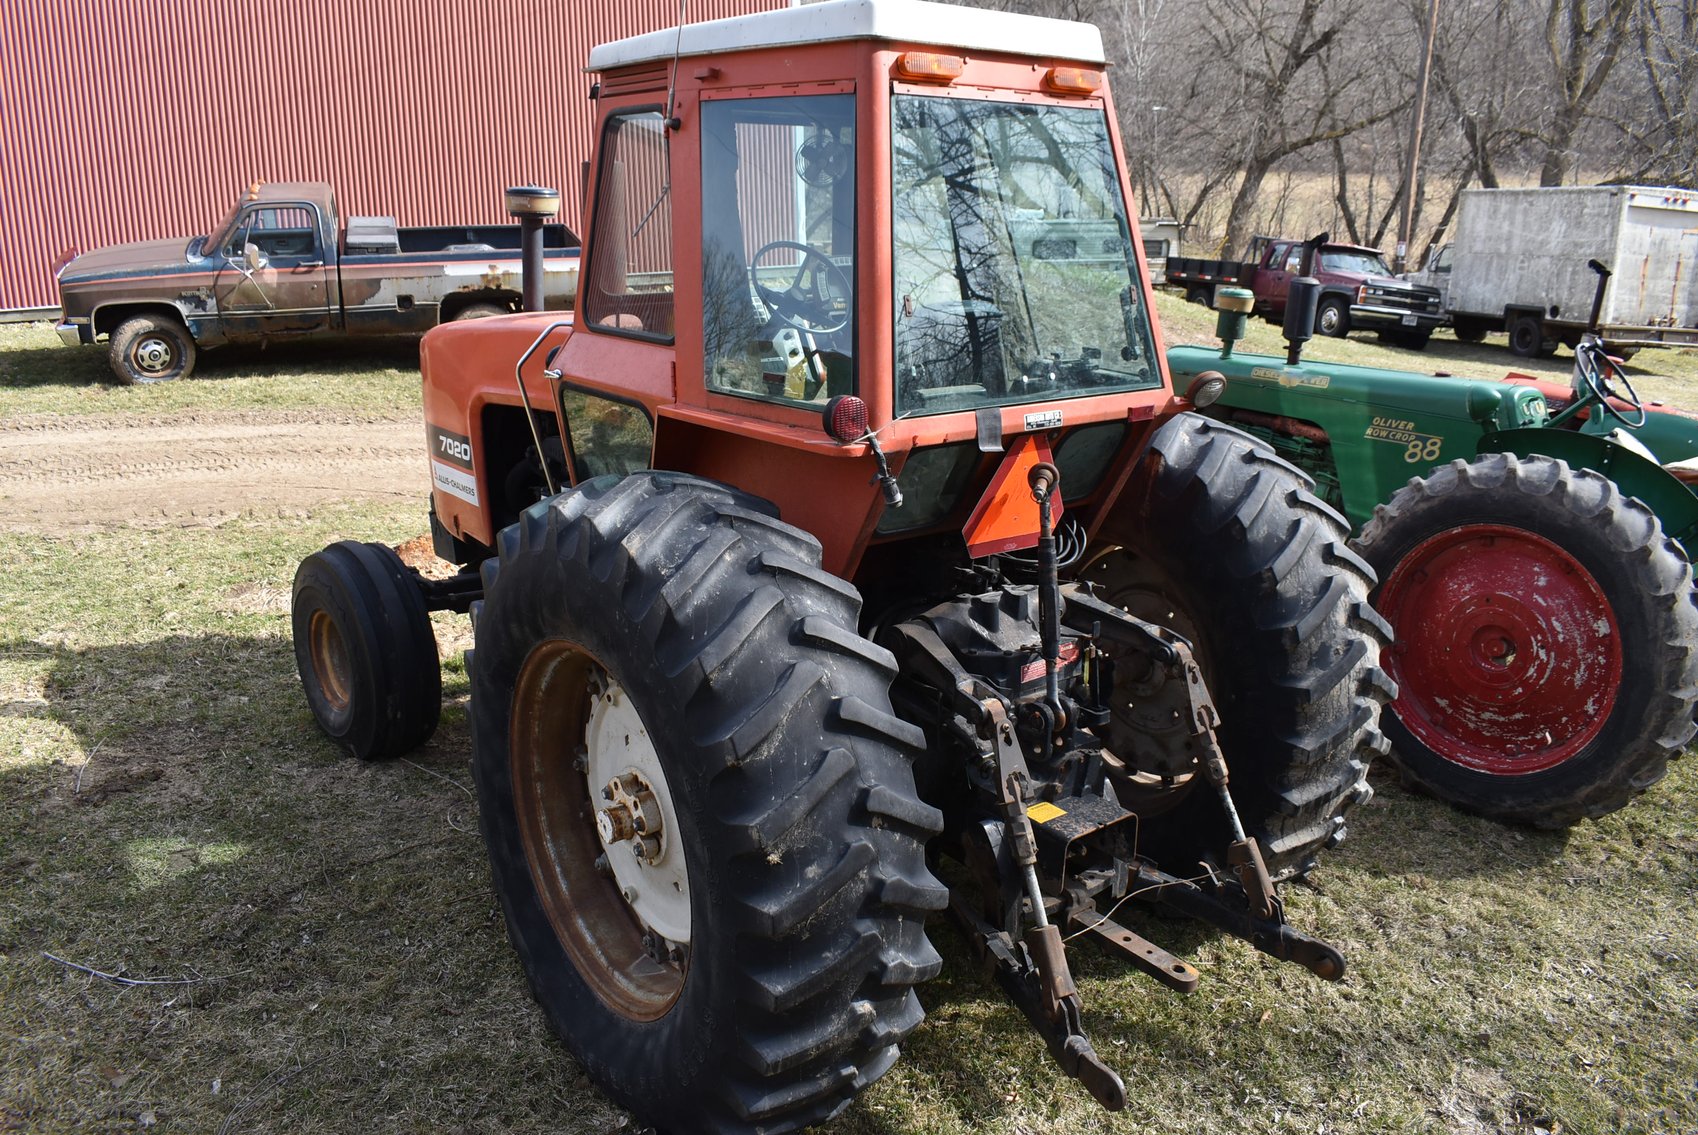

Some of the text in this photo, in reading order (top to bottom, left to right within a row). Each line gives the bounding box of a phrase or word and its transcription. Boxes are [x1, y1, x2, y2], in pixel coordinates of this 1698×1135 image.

[1365, 427, 1416, 442] ROW CROP
[1372, 416, 1415, 431] OLIVER
[438, 435, 471, 461] 7020
[1404, 438, 1442, 463] 88
[438, 474, 476, 497] ALLIS-CHALMERS
